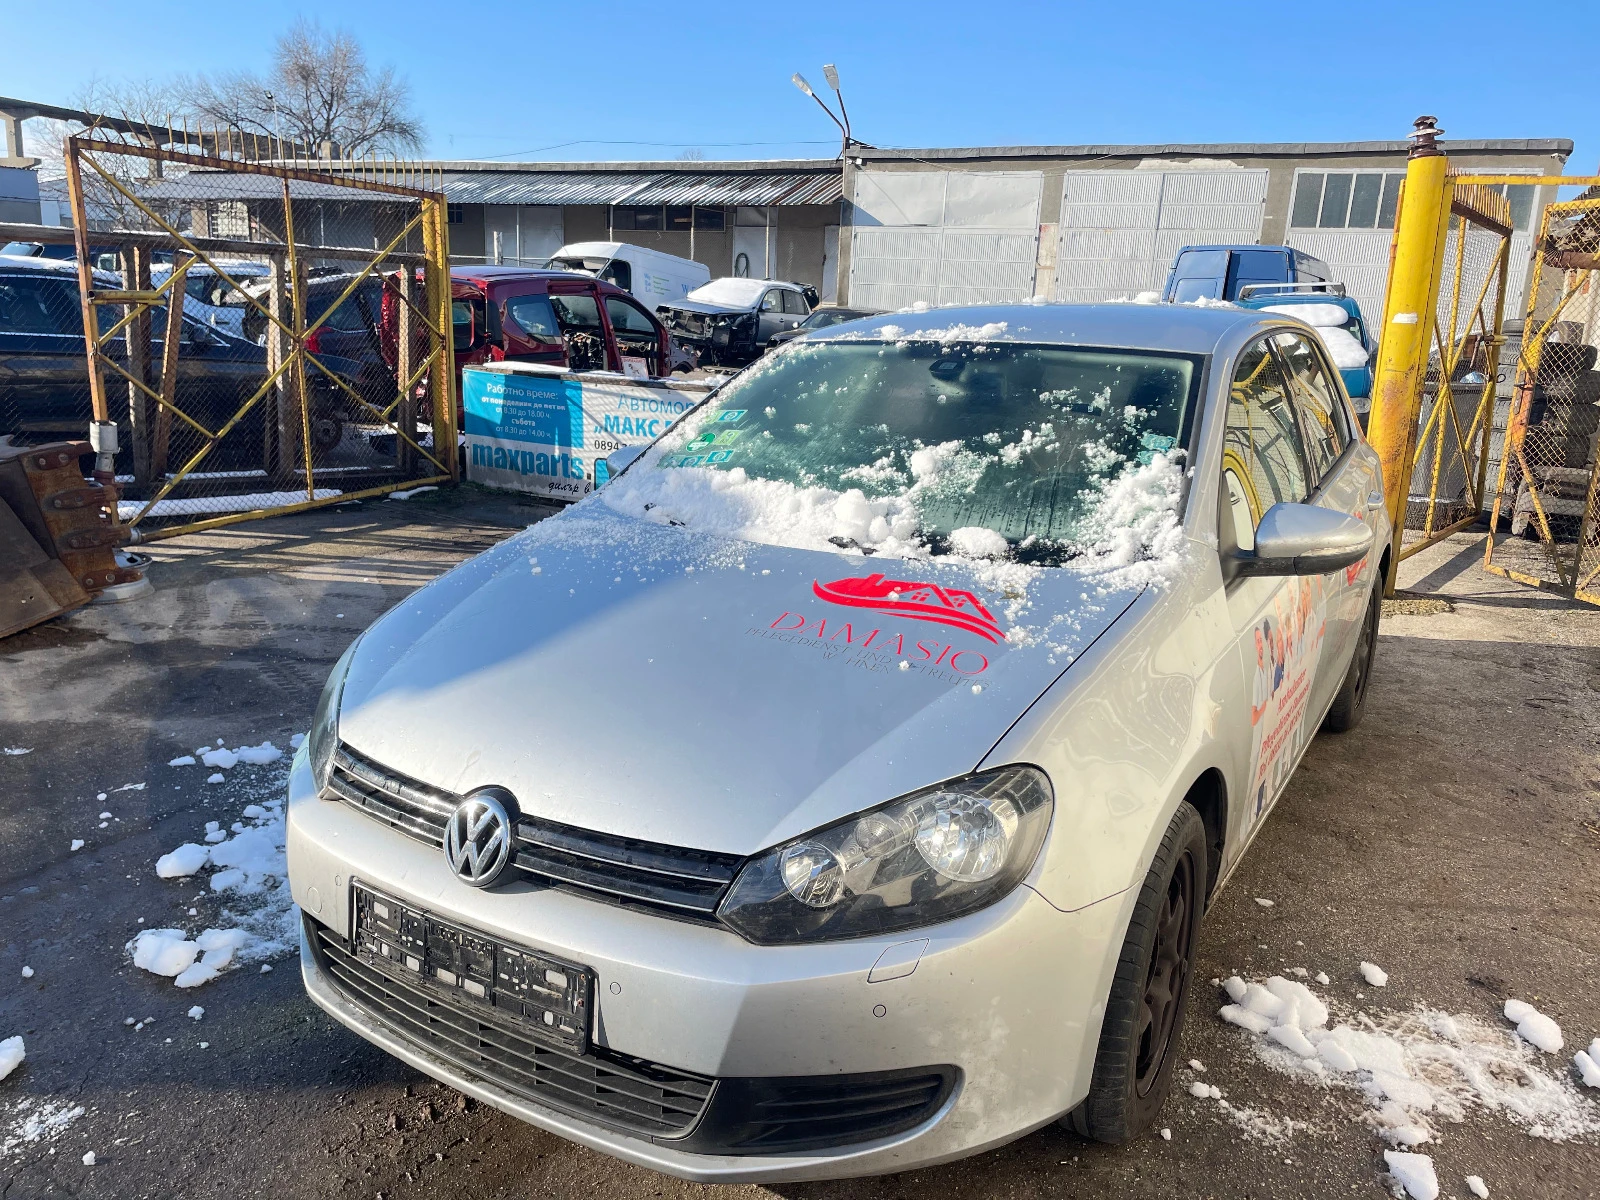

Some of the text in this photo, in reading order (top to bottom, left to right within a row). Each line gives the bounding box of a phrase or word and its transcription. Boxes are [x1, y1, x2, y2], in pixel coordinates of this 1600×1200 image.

[487, 383, 559, 400] Работно време:
[503, 407, 517, 415] 8.30
[528, 409, 545, 418] 18.00
[511, 418, 536, 427] събота
[504, 425, 518, 434] 8.30
[594, 439, 619, 451] 0894
[769, 611, 989, 675] DAMASIO
[856, 649, 893, 664] UND
